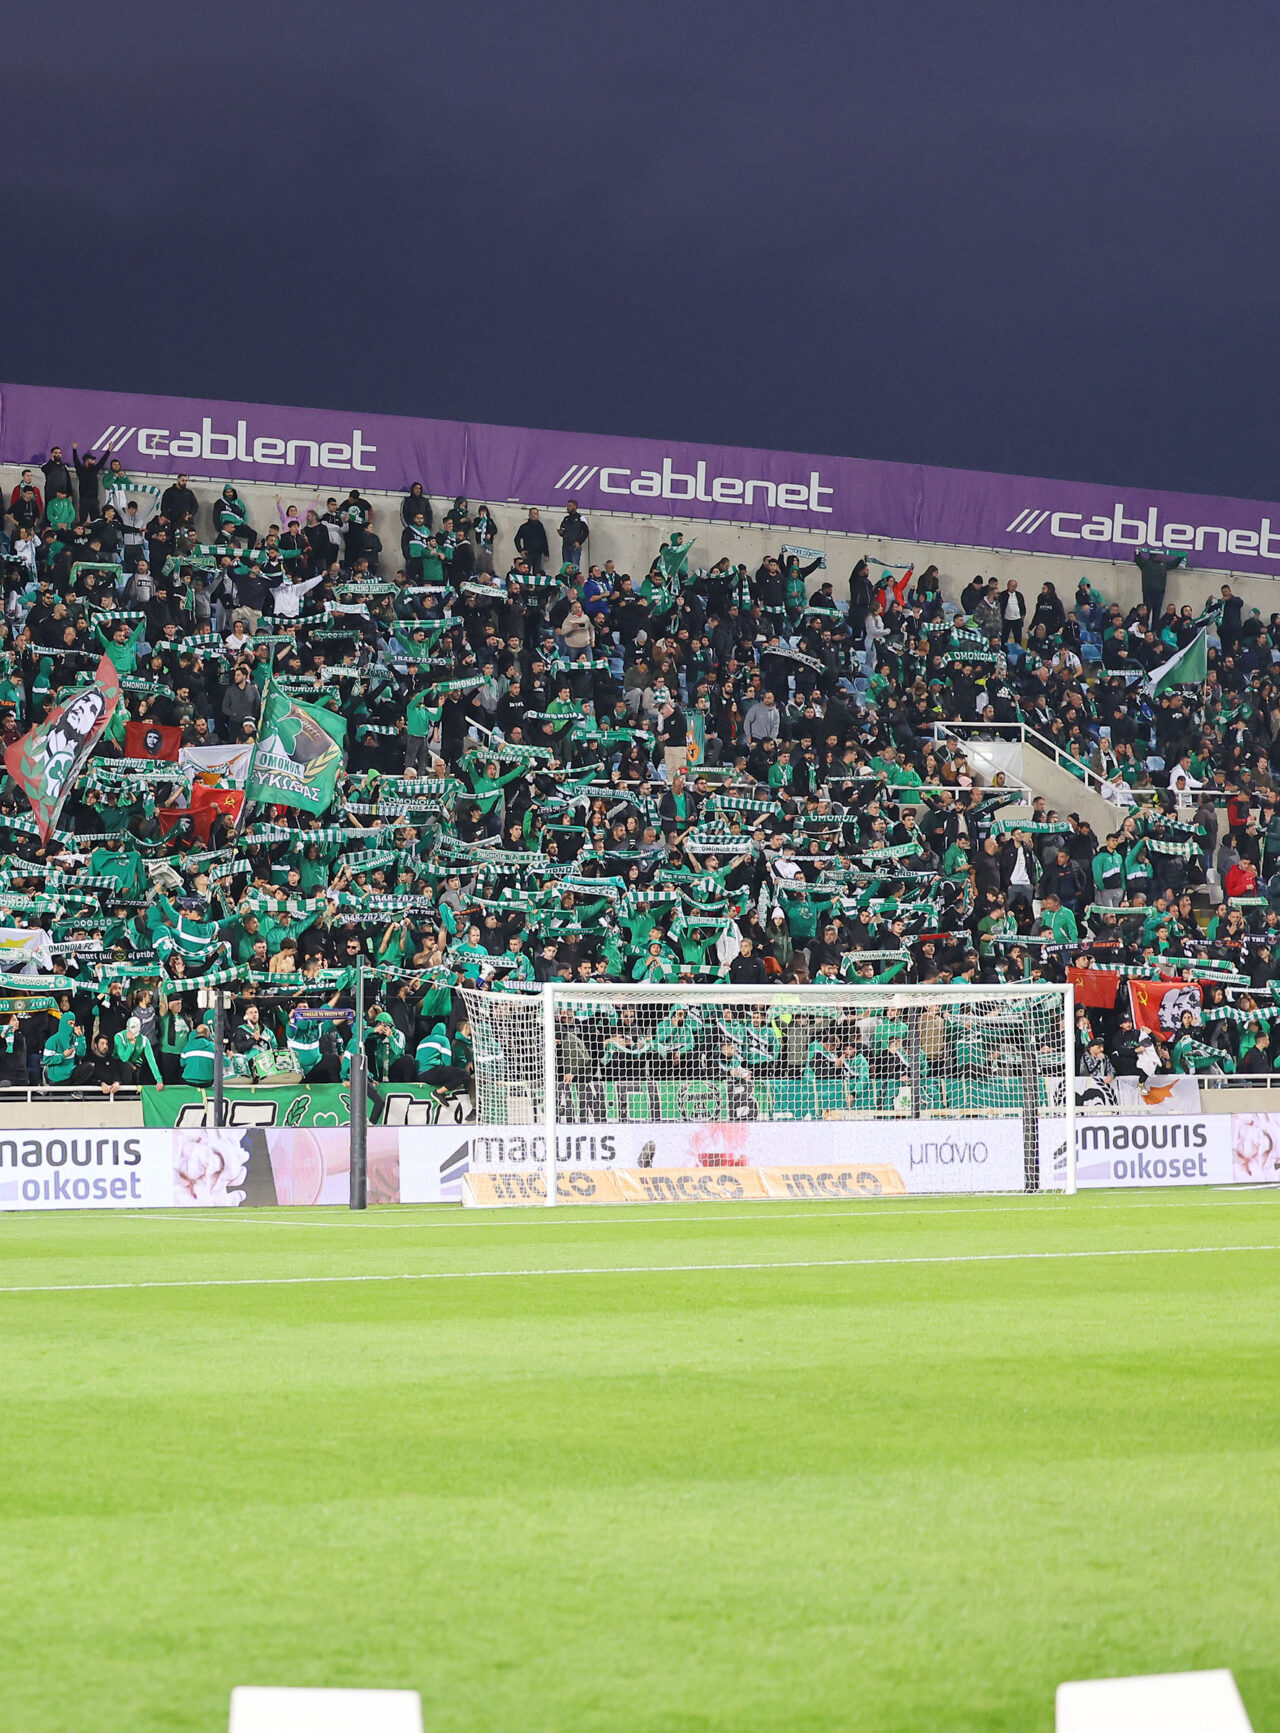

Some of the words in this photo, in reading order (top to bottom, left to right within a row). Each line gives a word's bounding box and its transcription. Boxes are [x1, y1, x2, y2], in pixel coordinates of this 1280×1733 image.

[137, 417, 377, 472] cablenet
[598, 456, 834, 513] cablenet
[1050, 503, 1280, 558] cablenet
[393, 655, 438, 665] 1948-2023
[954, 652, 993, 661] OMONOIA
[122, 681, 151, 691] OMONOIA
[151, 684, 159, 692] FC
[448, 676, 484, 690] OMONOIA
[320, 685, 331, 693] FC
[477, 751, 521, 763] OMONOIA
[103, 757, 147, 769] OMONOIA
[389, 798, 436, 806] OMONOIA
[810, 815, 858, 823] OMONOIA
[1006, 819, 1038, 829] OMONOIA
[49, 943, 81, 953] OMONOIA
[630, 946, 640, 954] 76
[1046, 944, 1062, 952] HUNT
[137, 951, 154, 960] pride
[464, 952, 508, 960] OMONOIA
[13, 977, 48, 986] OMONOIA
[1081, 1123, 1207, 1150] maouris
[909, 1136, 989, 1171] μπάνιο
[1113, 1153, 1208, 1179] oikoset
[22, 1170, 142, 1201] oikoset
